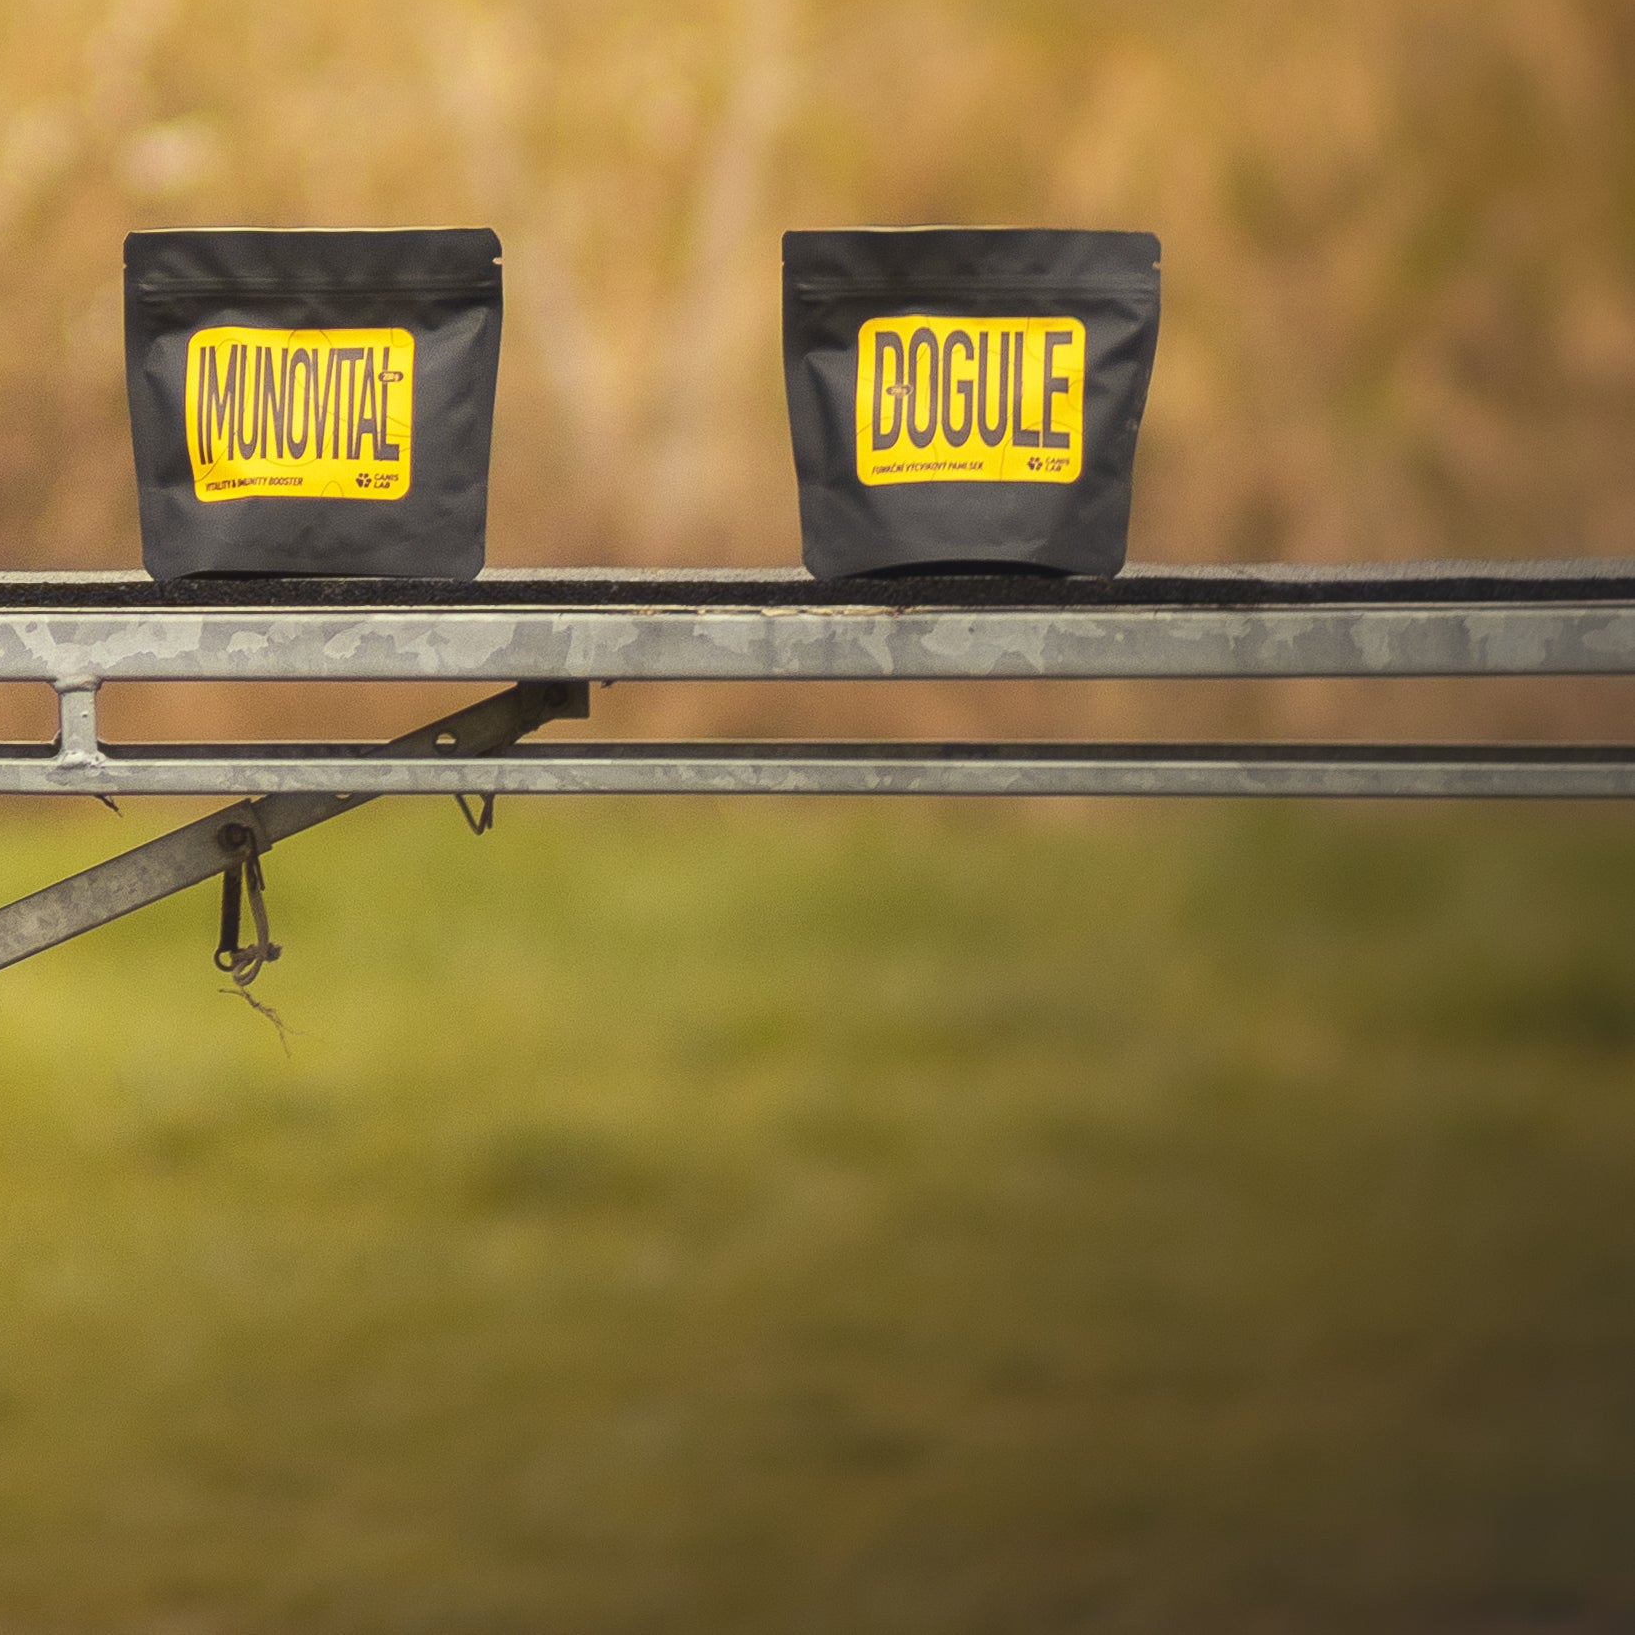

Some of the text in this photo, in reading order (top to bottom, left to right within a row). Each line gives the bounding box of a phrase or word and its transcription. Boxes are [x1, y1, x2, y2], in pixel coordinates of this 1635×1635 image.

[872, 327, 1073, 452] DOGULE
[198, 344, 400, 465] IMUNOVITAL
[269, 477, 304, 487] BOOSTER
[374, 473, 399, 482] CANIS
[373, 481, 391, 489] LAB
